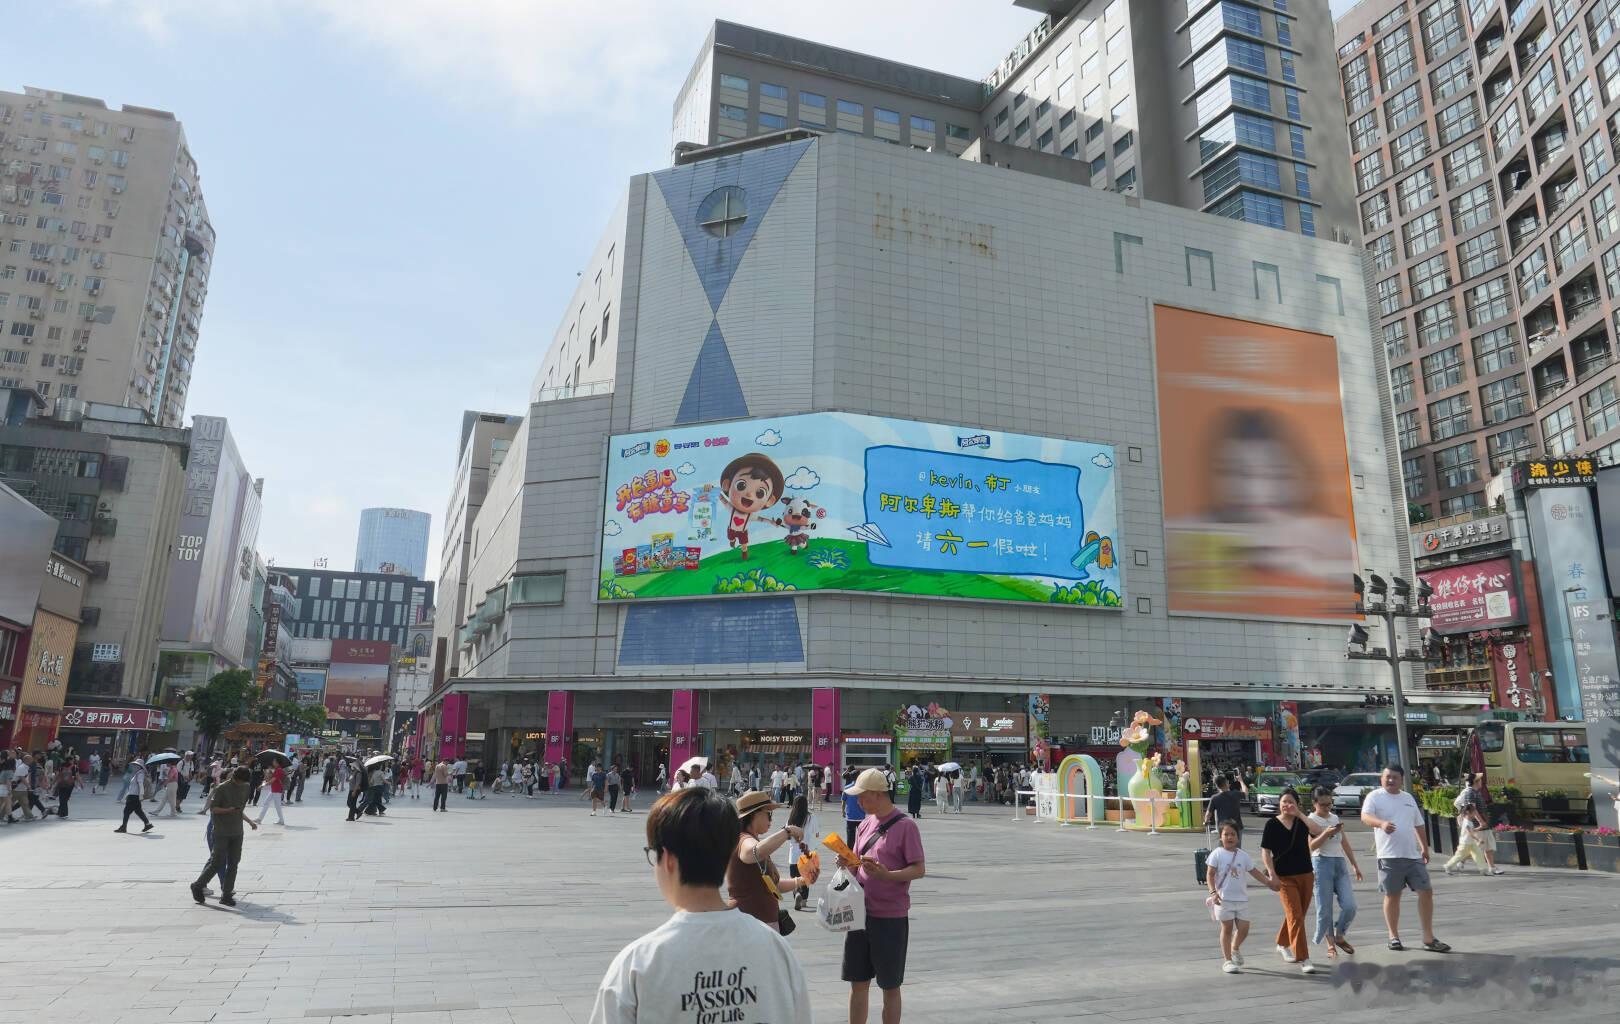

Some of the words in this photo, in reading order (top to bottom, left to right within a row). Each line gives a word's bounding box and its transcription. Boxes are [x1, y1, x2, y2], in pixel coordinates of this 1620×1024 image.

[183, 416, 226, 518] 如家酒店
[616, 469, 678, 512] 开启童心
[880, 493, 1072, 529] 阿尔卑斯帮你给爸爸妈妈
[180, 535, 203, 548] TOP
[178, 548, 201, 561] TOY
[1572, 605, 1590, 618] IFS
[38, 650, 65, 676] 周六福
[86, 712, 135, 725] 都市丽人
[908, 719, 944, 731] 熊猫冰粉
[760, 735, 780, 743] NOISY
[781, 735, 803, 743] TEDDY
[690, 969, 723, 995] full
[728, 966, 748, 989] of
[681, 986, 758, 1013] PASSION
[696, 1009, 720, 1024] for
[721, 1007, 745, 1023] Life
